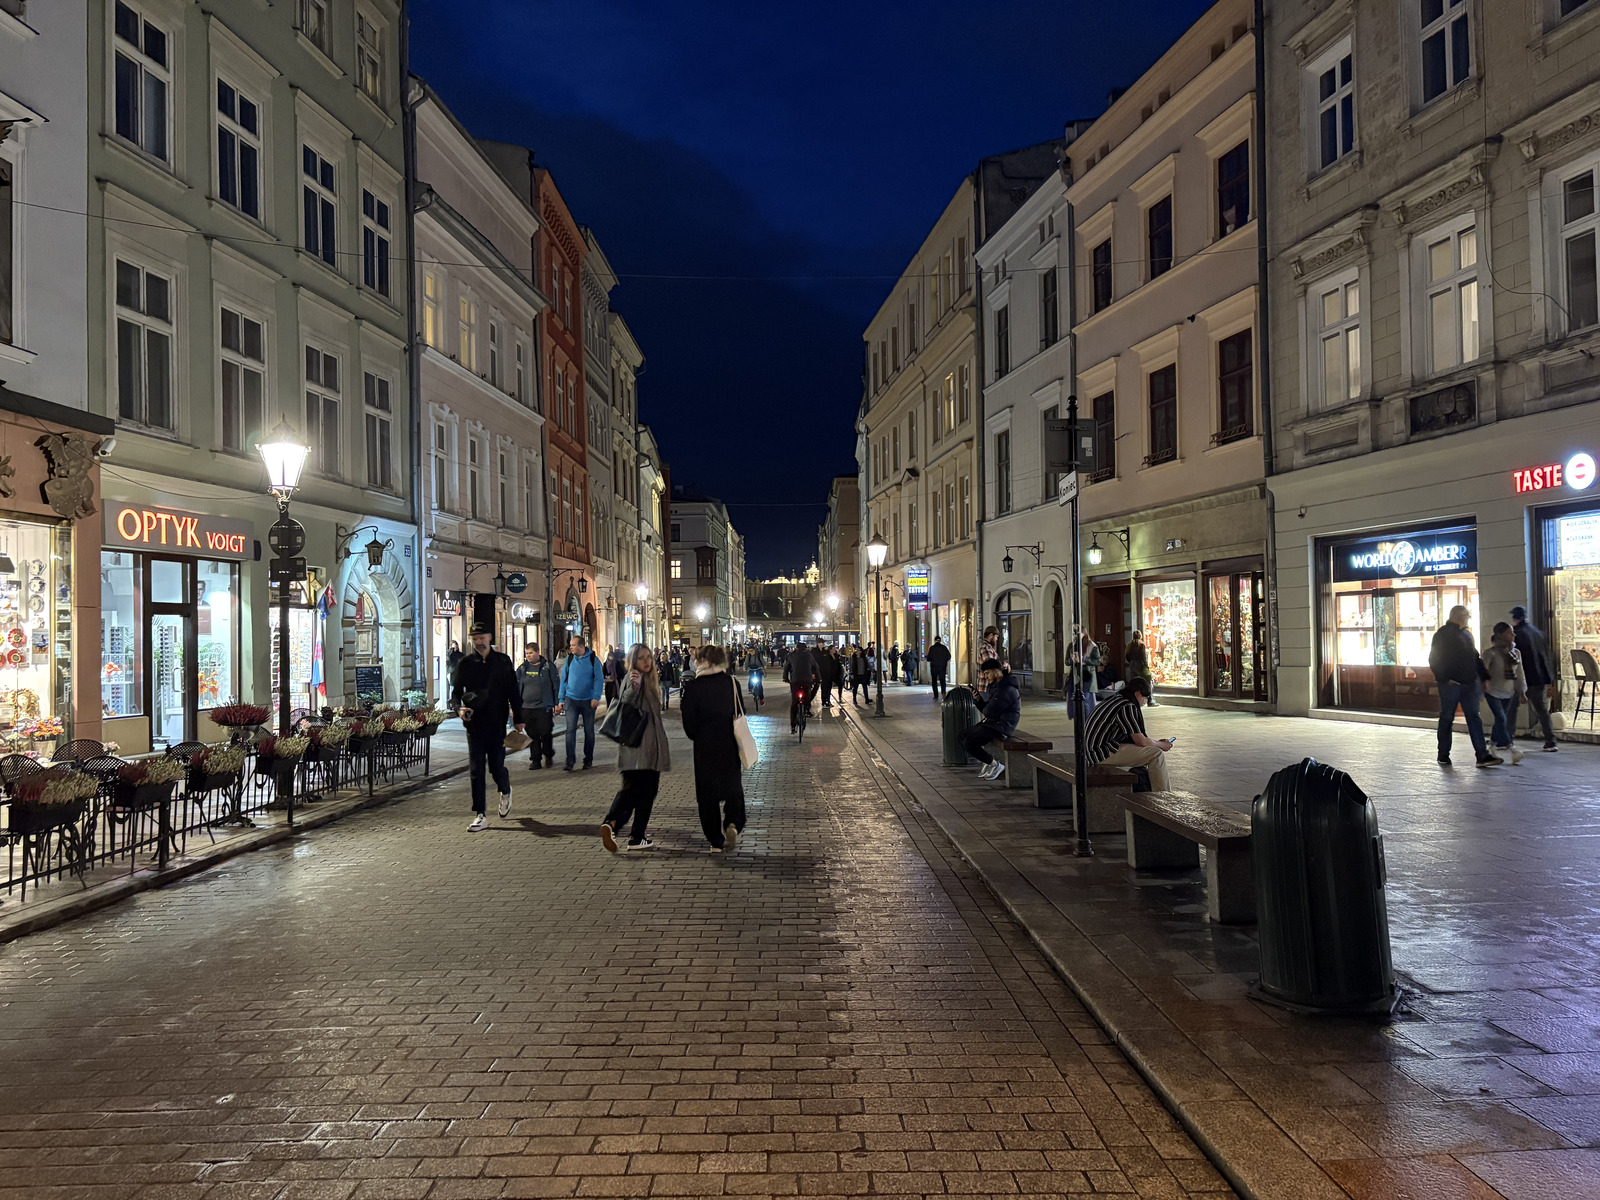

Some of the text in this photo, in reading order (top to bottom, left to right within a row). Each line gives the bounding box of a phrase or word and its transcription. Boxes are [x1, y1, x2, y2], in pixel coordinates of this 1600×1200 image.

[1060, 481, 1076, 498] Koniec
[1513, 464, 1562, 493] TASTE
[117, 508, 246, 553] OPTYK VOIGT
[1352, 552, 1393, 569] WORLD
[1415, 545, 1460, 563] AMBER
[437, 594, 457, 610] LODY
